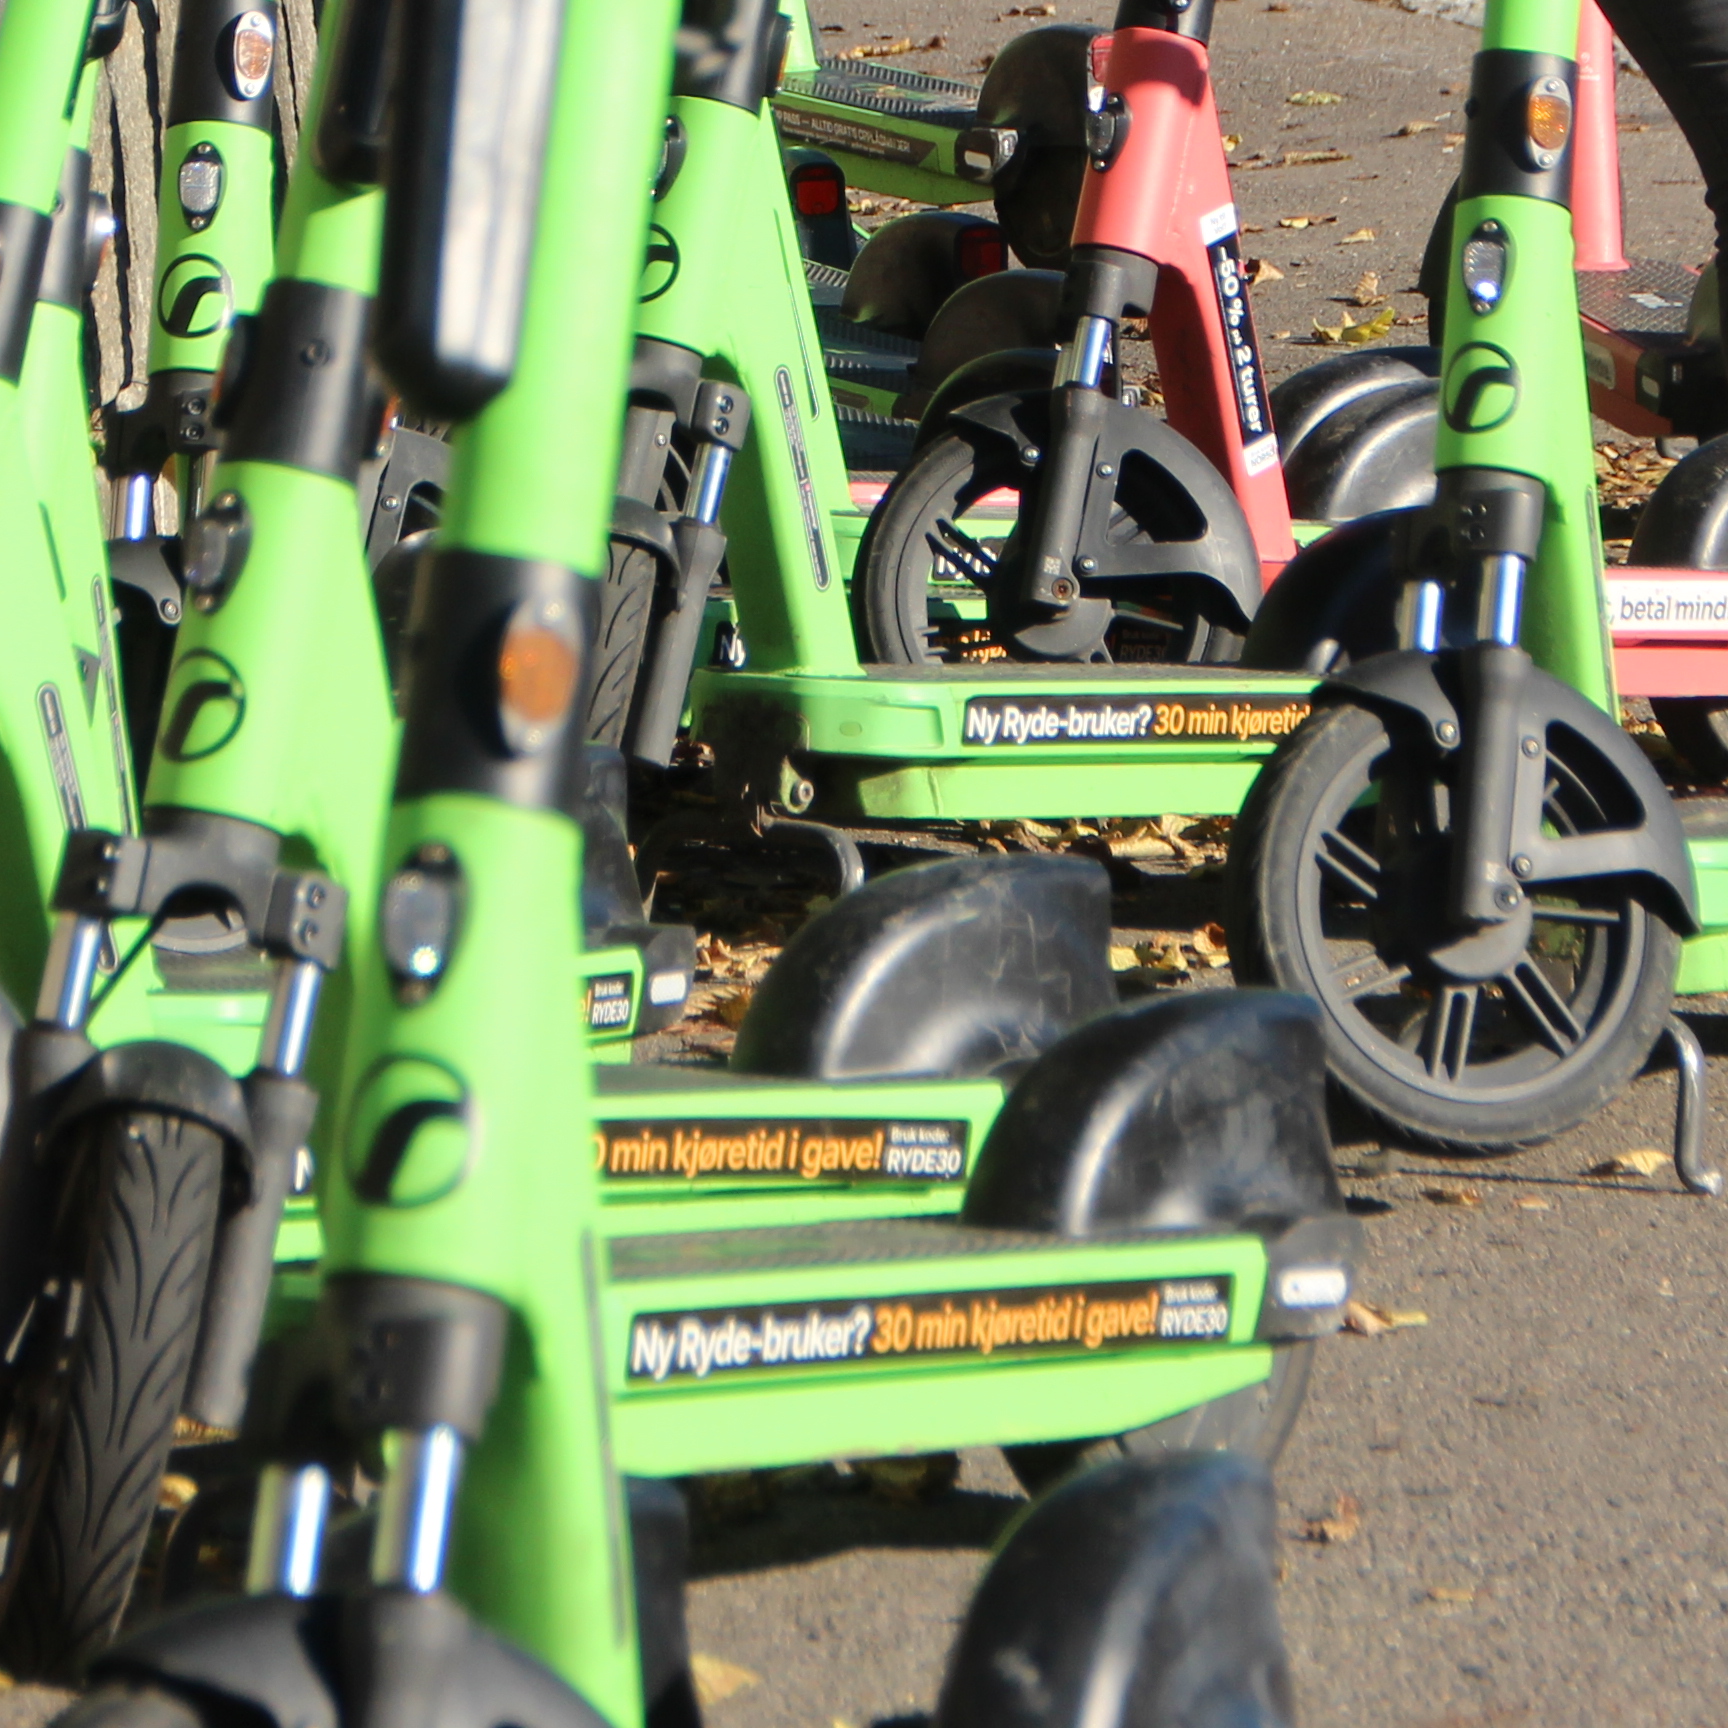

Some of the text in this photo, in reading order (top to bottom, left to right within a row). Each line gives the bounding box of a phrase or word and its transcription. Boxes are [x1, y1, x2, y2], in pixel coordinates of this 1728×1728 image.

[1236, 345, 1253, 368] 2
[1240, 365, 1263, 433] turer
[1620, 595, 1672, 621] betal
[967, 705, 1000, 744] Ny
[1003, 704, 1153, 744] Ryde-bruker?
[1154, 704, 1185, 736] 30
[1187, 702, 1228, 735] min
[591, 999, 630, 1025] RYDE30
[890, 1126, 918, 1144] Bruk
[610, 1126, 669, 1172] min
[673, 1128, 786, 1179] kjøretid
[787, 1127, 802, 1170] i
[801, 1130, 885, 1179] gave!
[886, 1146, 962, 1175] RYDE30
[631, 1286, 1160, 1382] Ny Ryde-bruker? 30 min kjøretid i gave!
[1159, 1302, 1229, 1338] RYDE30
